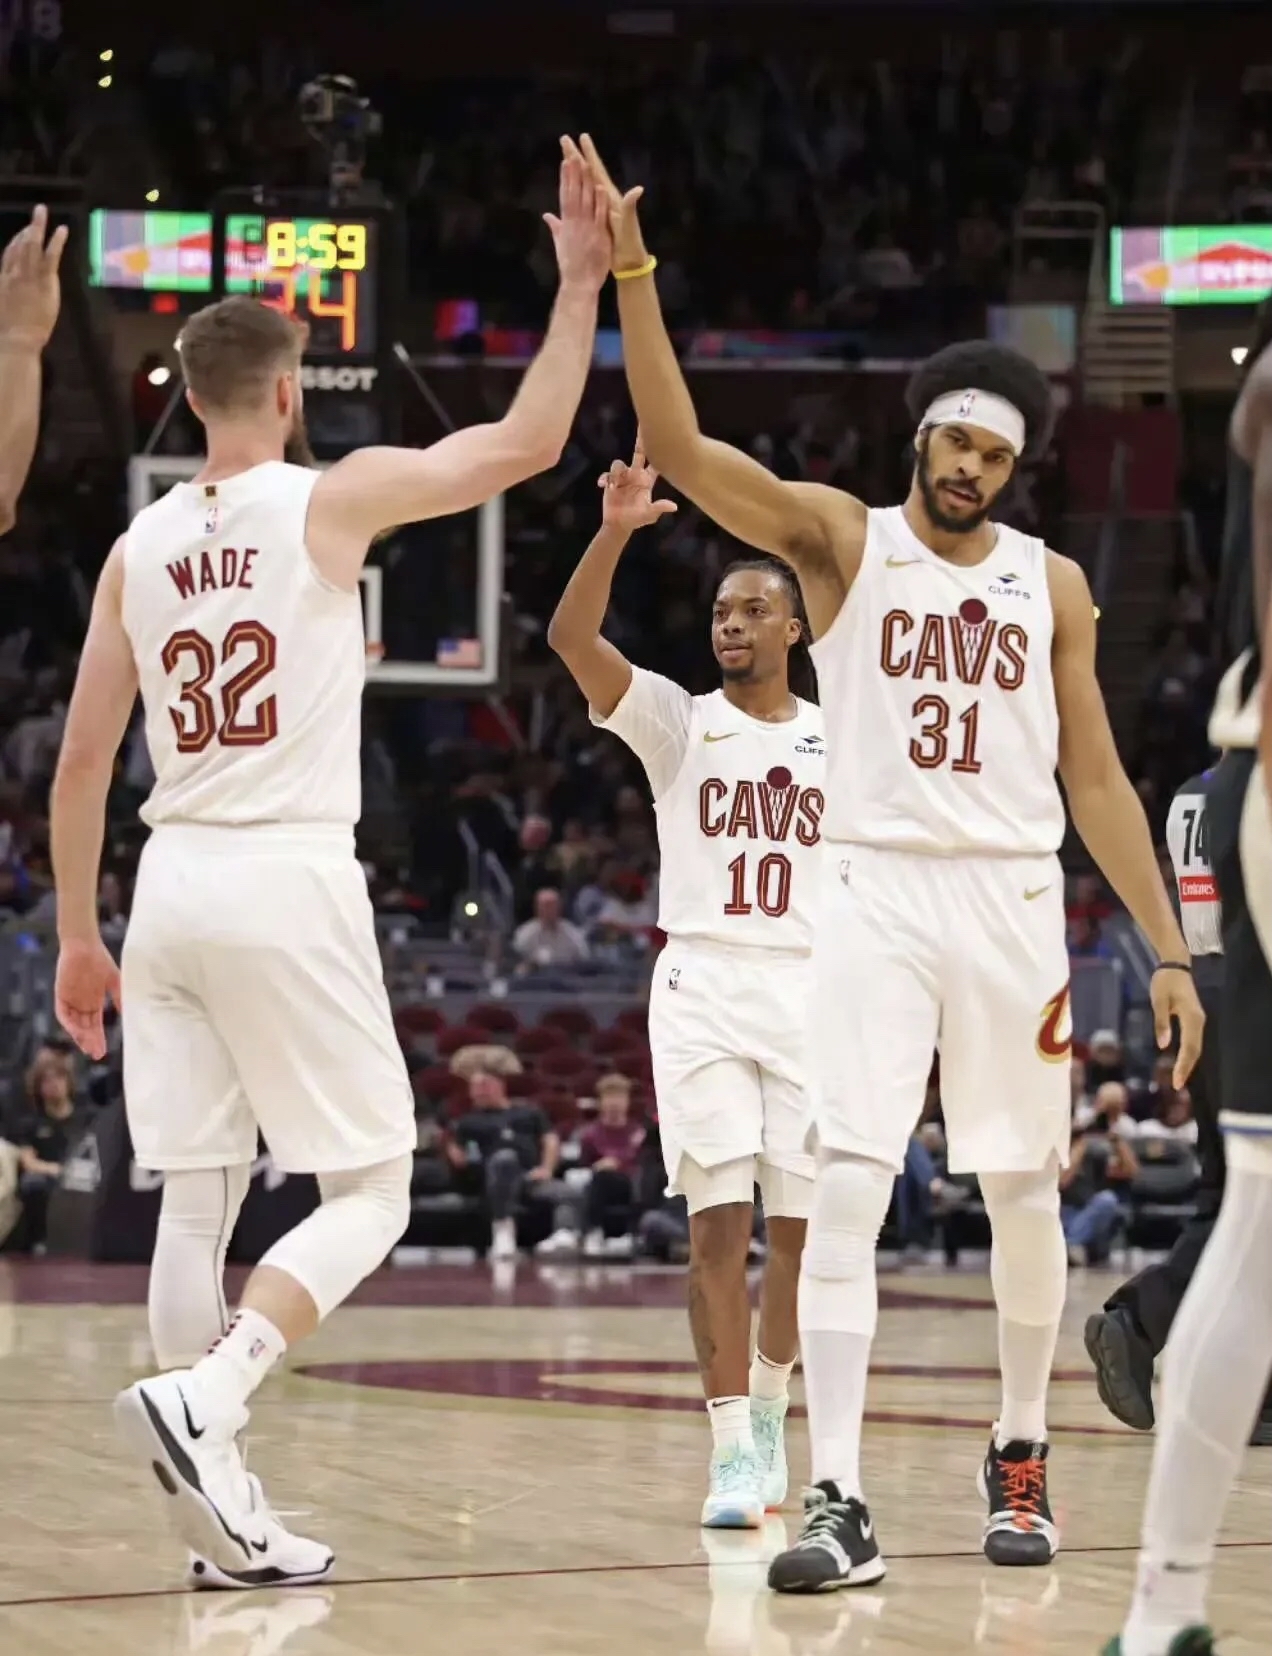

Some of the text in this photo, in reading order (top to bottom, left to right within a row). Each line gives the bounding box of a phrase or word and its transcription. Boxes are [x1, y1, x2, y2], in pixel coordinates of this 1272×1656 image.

[266, 221, 366, 271] 8:59
[301, 365, 378, 391] SSOT
[165, 547, 259, 600] WADE
[880, 602, 1028, 691] CAVS
[161, 619, 278, 753] 32
[794, 745, 825, 756] CLIFF
[909, 693, 982, 774] 31
[700, 770, 825, 847] CAVS
[1183, 809, 1209, 866] 74
[723, 851, 792, 918] 10
